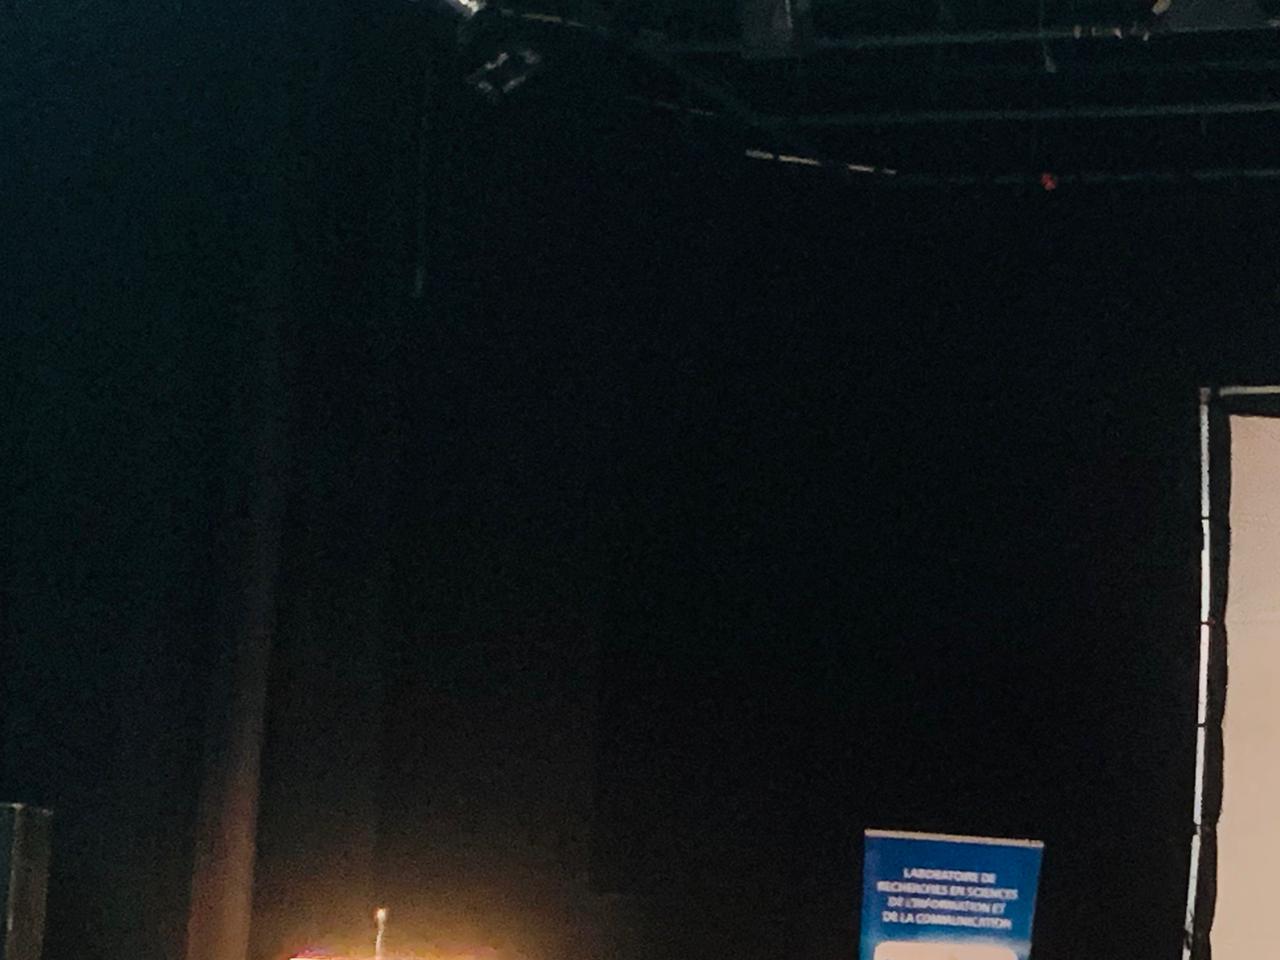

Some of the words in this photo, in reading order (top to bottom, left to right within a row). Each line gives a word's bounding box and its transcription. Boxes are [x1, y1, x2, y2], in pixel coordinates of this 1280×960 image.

[980, 872, 996, 884] DE
[950, 885, 966, 896] EN
[967, 886, 1018, 900] SCIENCES
[887, 896, 904, 907] DE
[991, 902, 1006, 914] ET
[900, 912, 914, 923] LA
[915, 913, 1012, 930] COMMUNICATION
